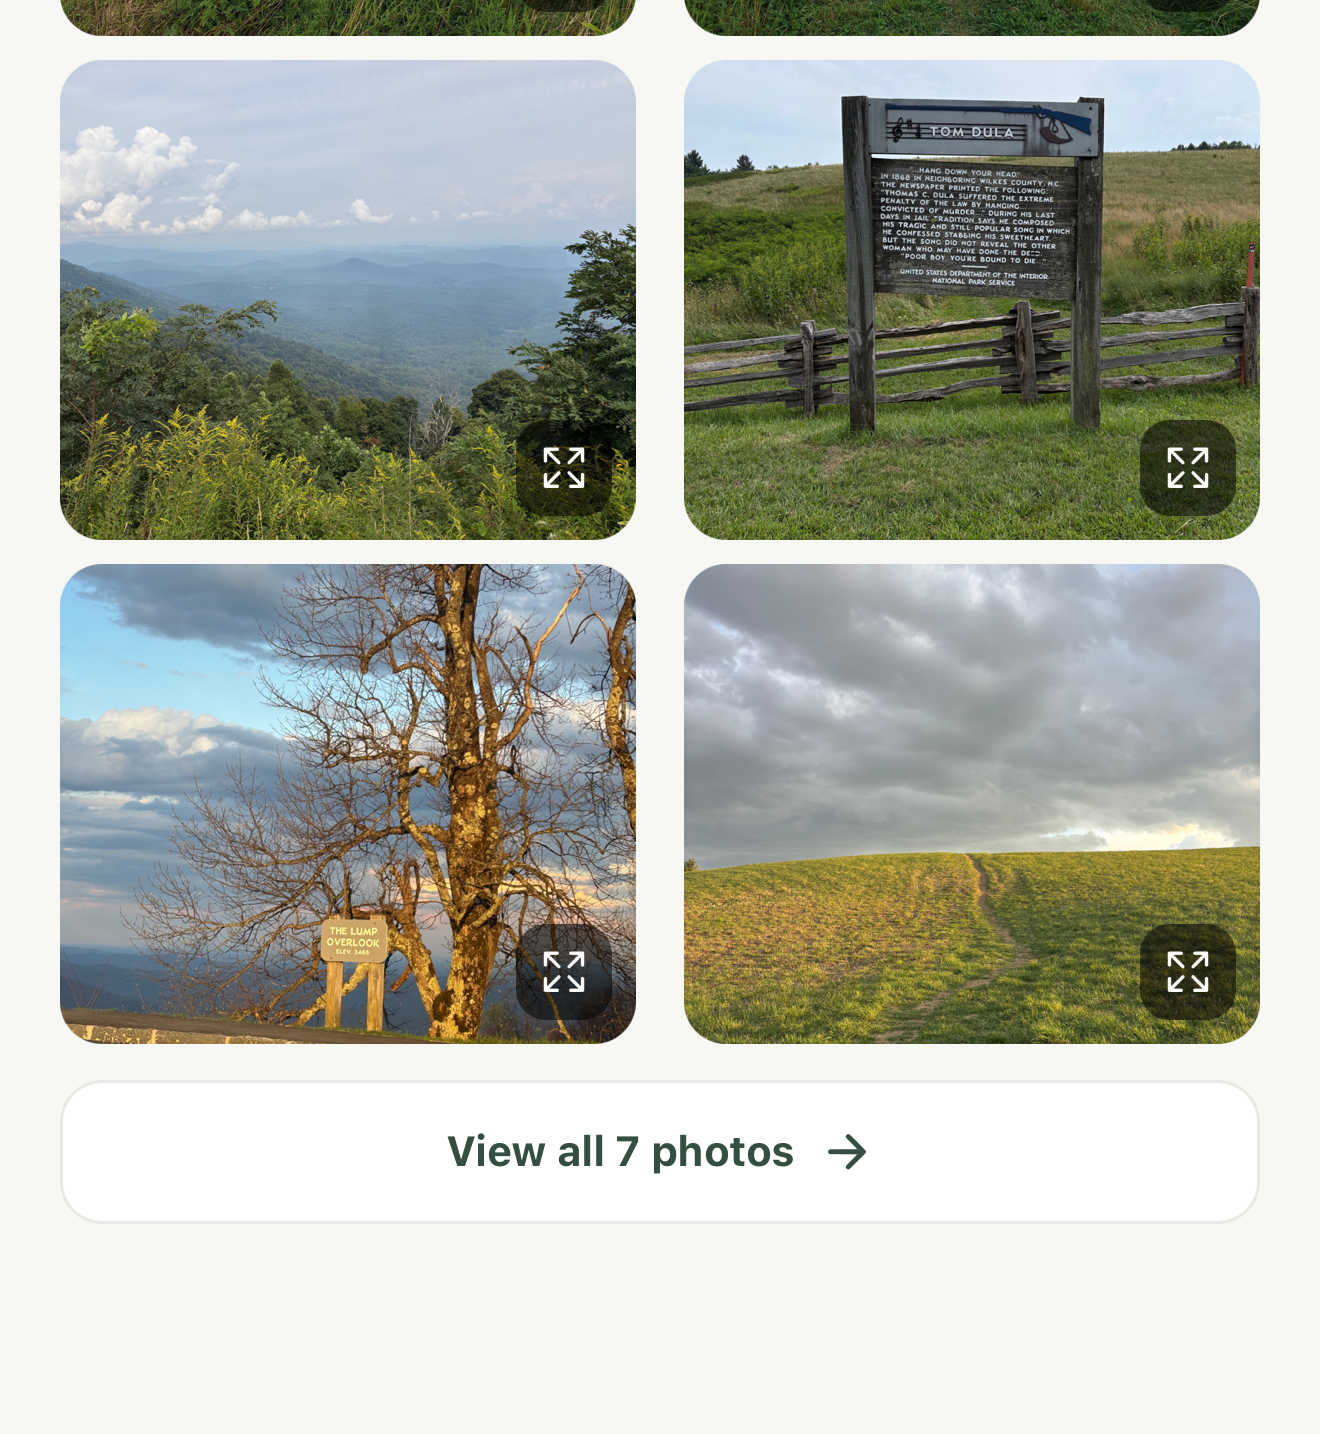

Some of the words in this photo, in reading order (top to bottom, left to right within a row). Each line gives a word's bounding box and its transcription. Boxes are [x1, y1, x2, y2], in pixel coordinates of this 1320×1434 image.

[930, 126, 964, 137] TOM
[972, 127, 1014, 138] DULA
[958, 193, 997, 201] SUFFERED
[896, 229, 940, 237] CONFESSED
[950, 270, 992, 278] DEPARTMENT
[932, 277, 965, 285] NATIONAL
[330, 927, 347, 935] THE
[351, 927, 378, 936] LUMP
[327, 938, 379, 947] OVERLOOK
[447, 1133, 545, 1167] View
[559, 1134, 602, 1167] all
[617, 1136, 638, 1166] 7
[654, 1134, 793, 1174] photos
